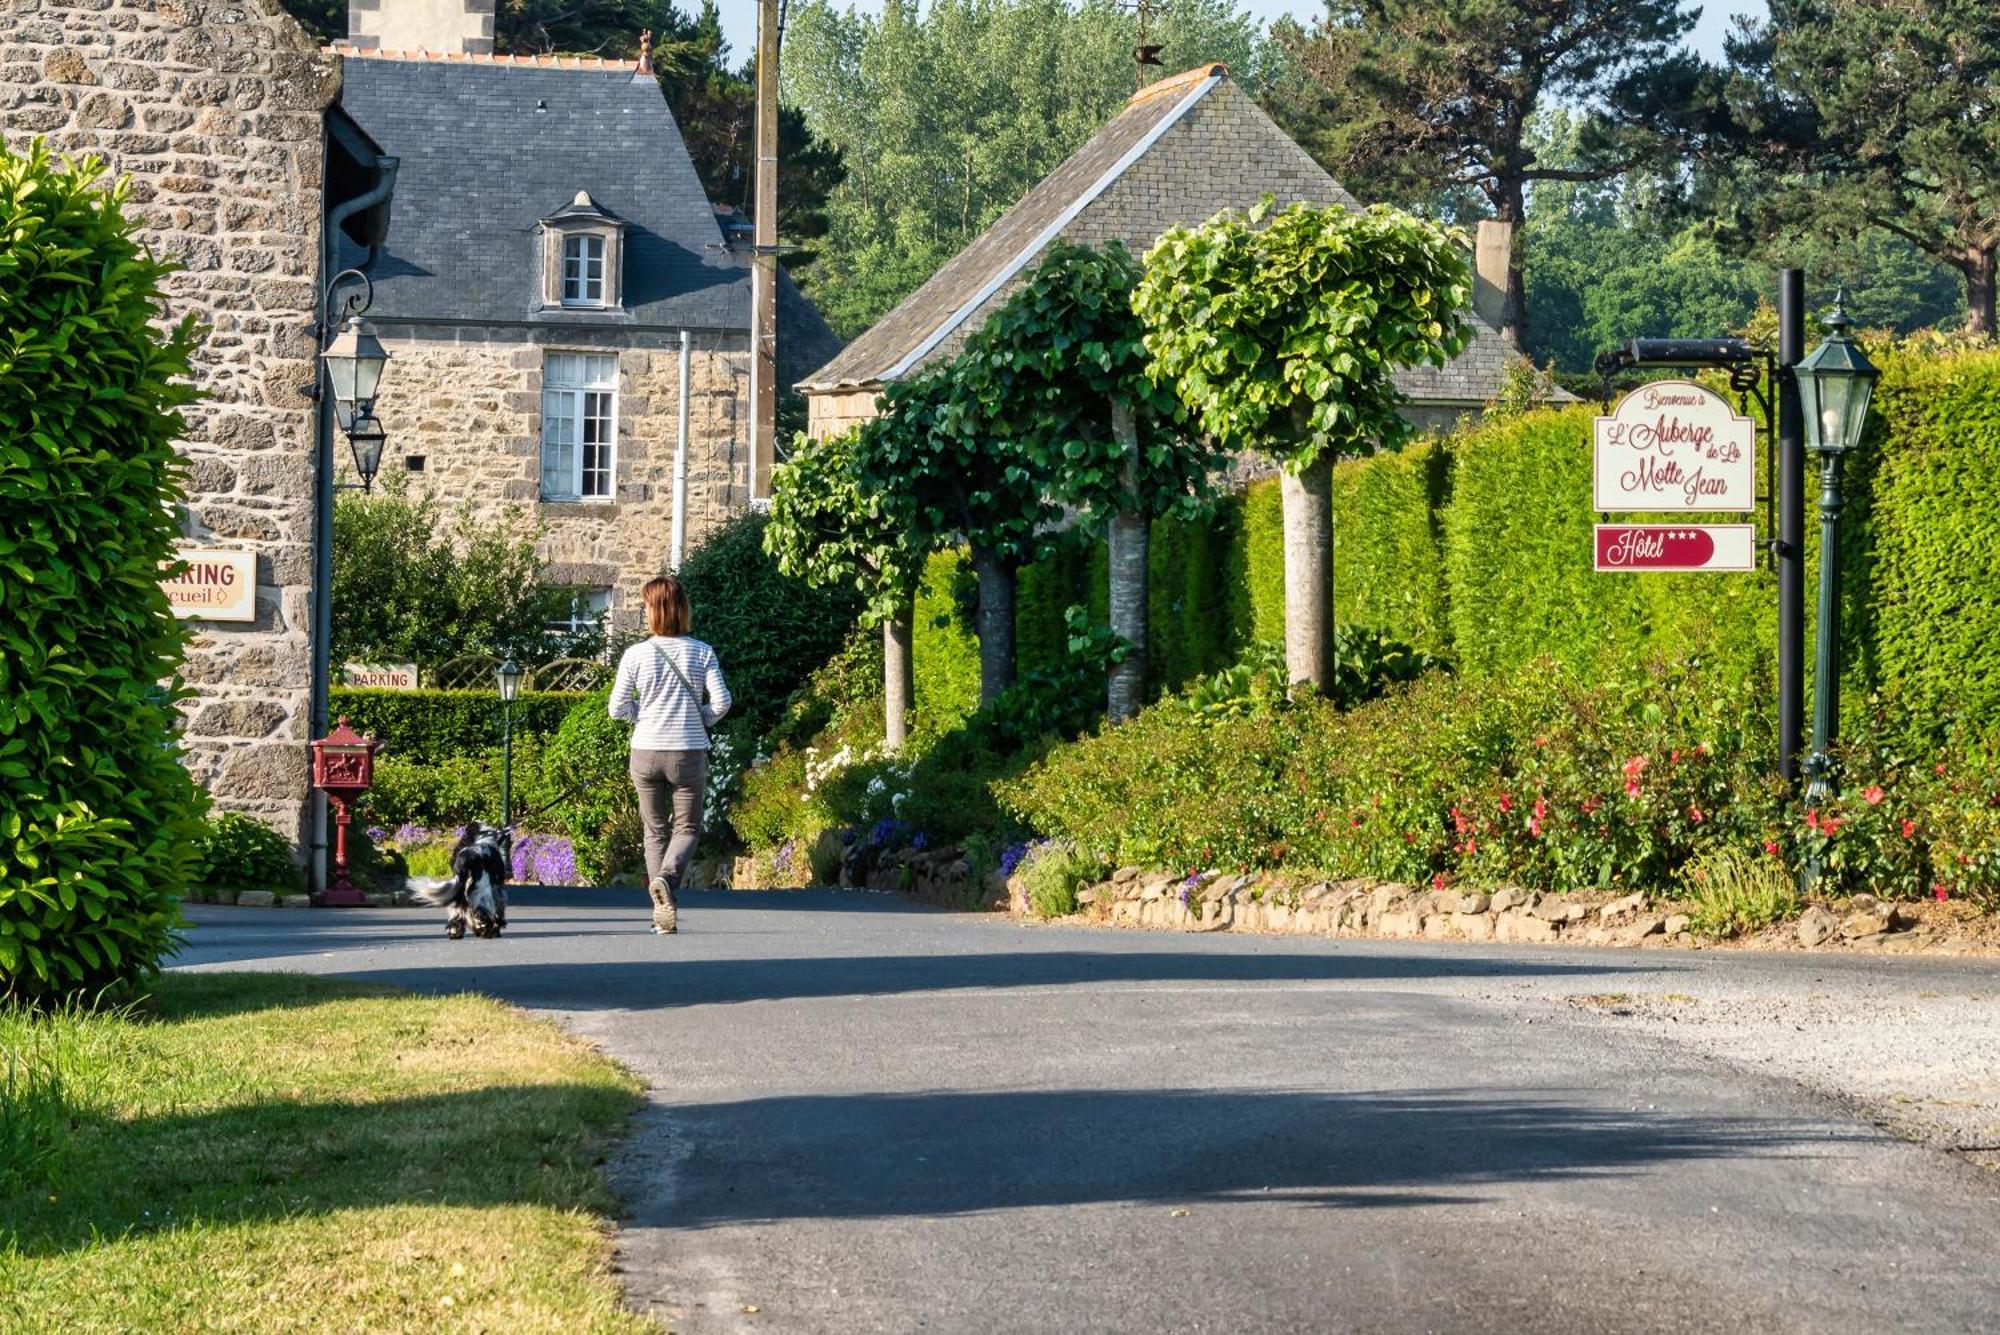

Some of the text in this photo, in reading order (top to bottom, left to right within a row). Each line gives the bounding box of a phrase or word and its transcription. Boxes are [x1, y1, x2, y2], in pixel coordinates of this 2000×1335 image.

[1644, 387, 1696, 410] Bienvenue
[1706, 441, 1741, 463] de La
[1620, 455, 1728, 506] Motte Jean
[1607, 529, 1664, 565] Hôtel
[167, 588, 212, 603] cueil
[354, 673, 408, 687] PARKING
